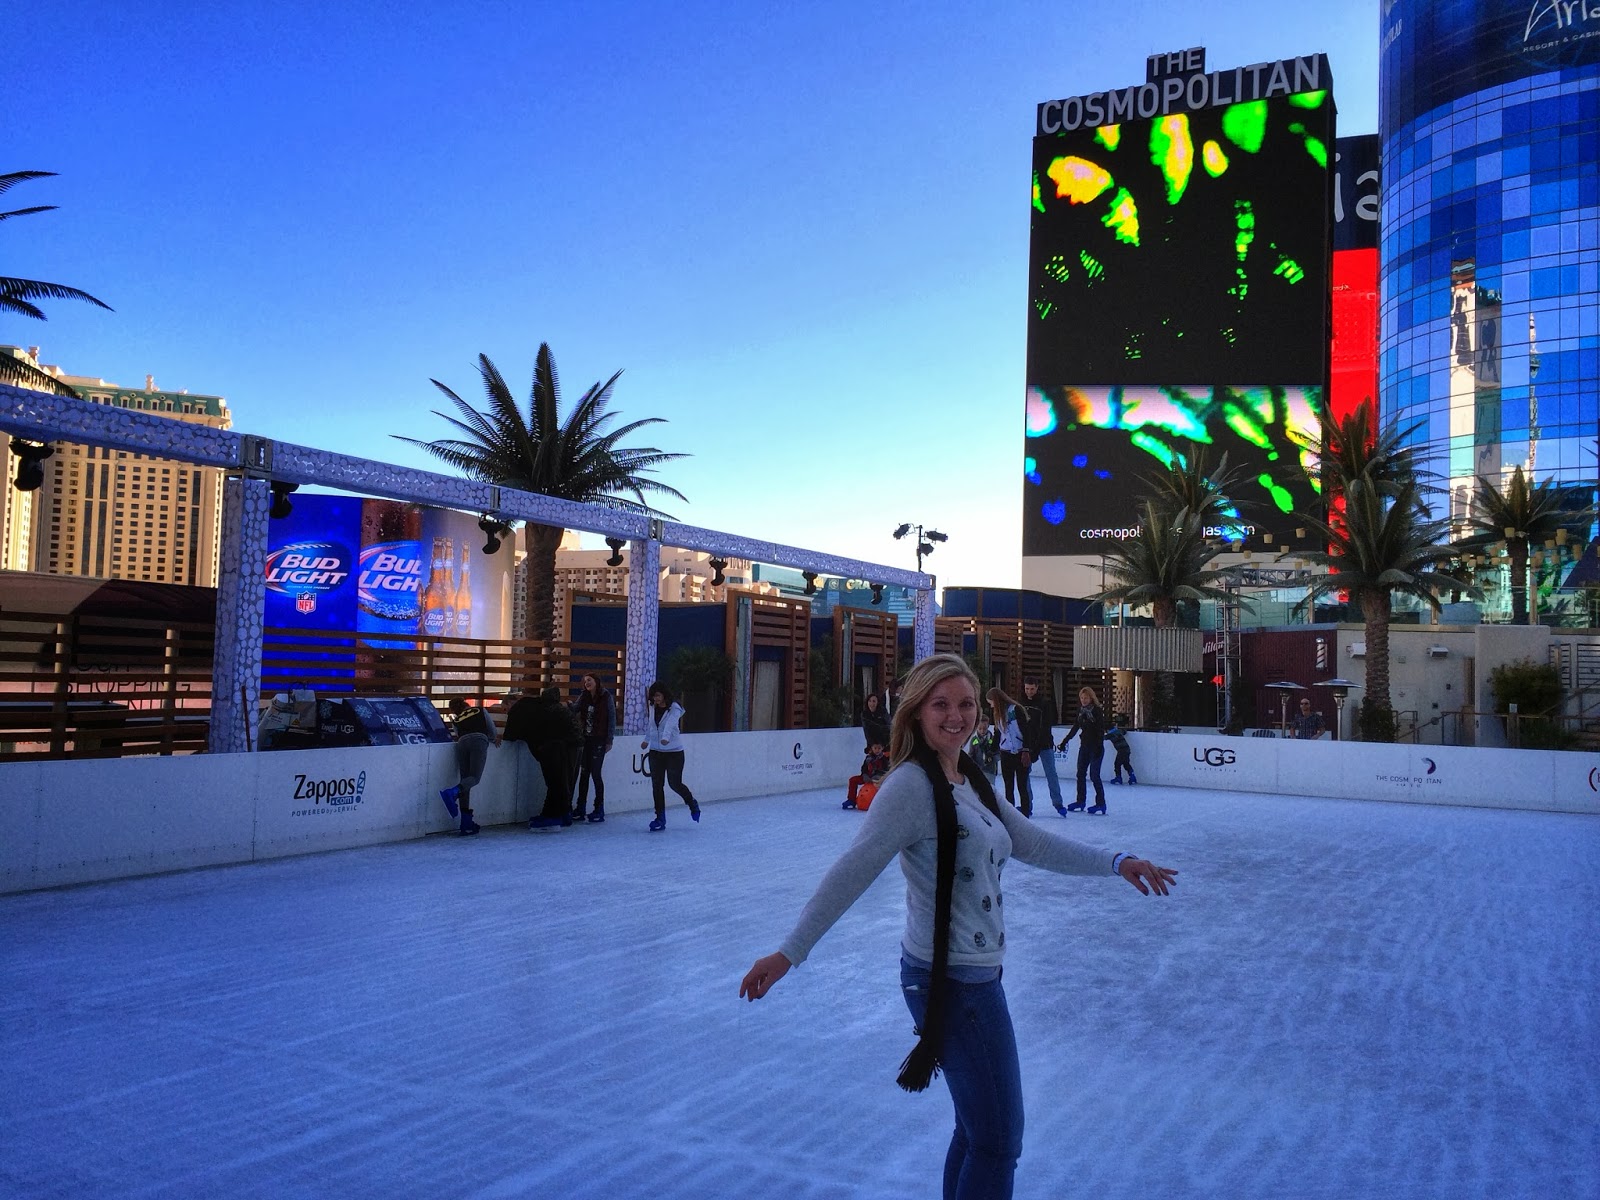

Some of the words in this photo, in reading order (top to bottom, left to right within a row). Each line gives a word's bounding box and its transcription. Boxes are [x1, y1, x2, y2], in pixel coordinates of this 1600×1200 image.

[1523, 41, 1560, 53] RESORT
[1149, 46, 1202, 76] THE
[1041, 53, 1320, 134] COSMOPOLITAN
[280, 554, 341, 570] BUD
[266, 568, 348, 585] LIGHT
[299, 601, 314, 610] NFL
[340, 725, 354, 734] UGG
[398, 734, 427, 746] UGG
[1193, 747, 1236, 767] UGG
[293, 774, 356, 805] Zappos
